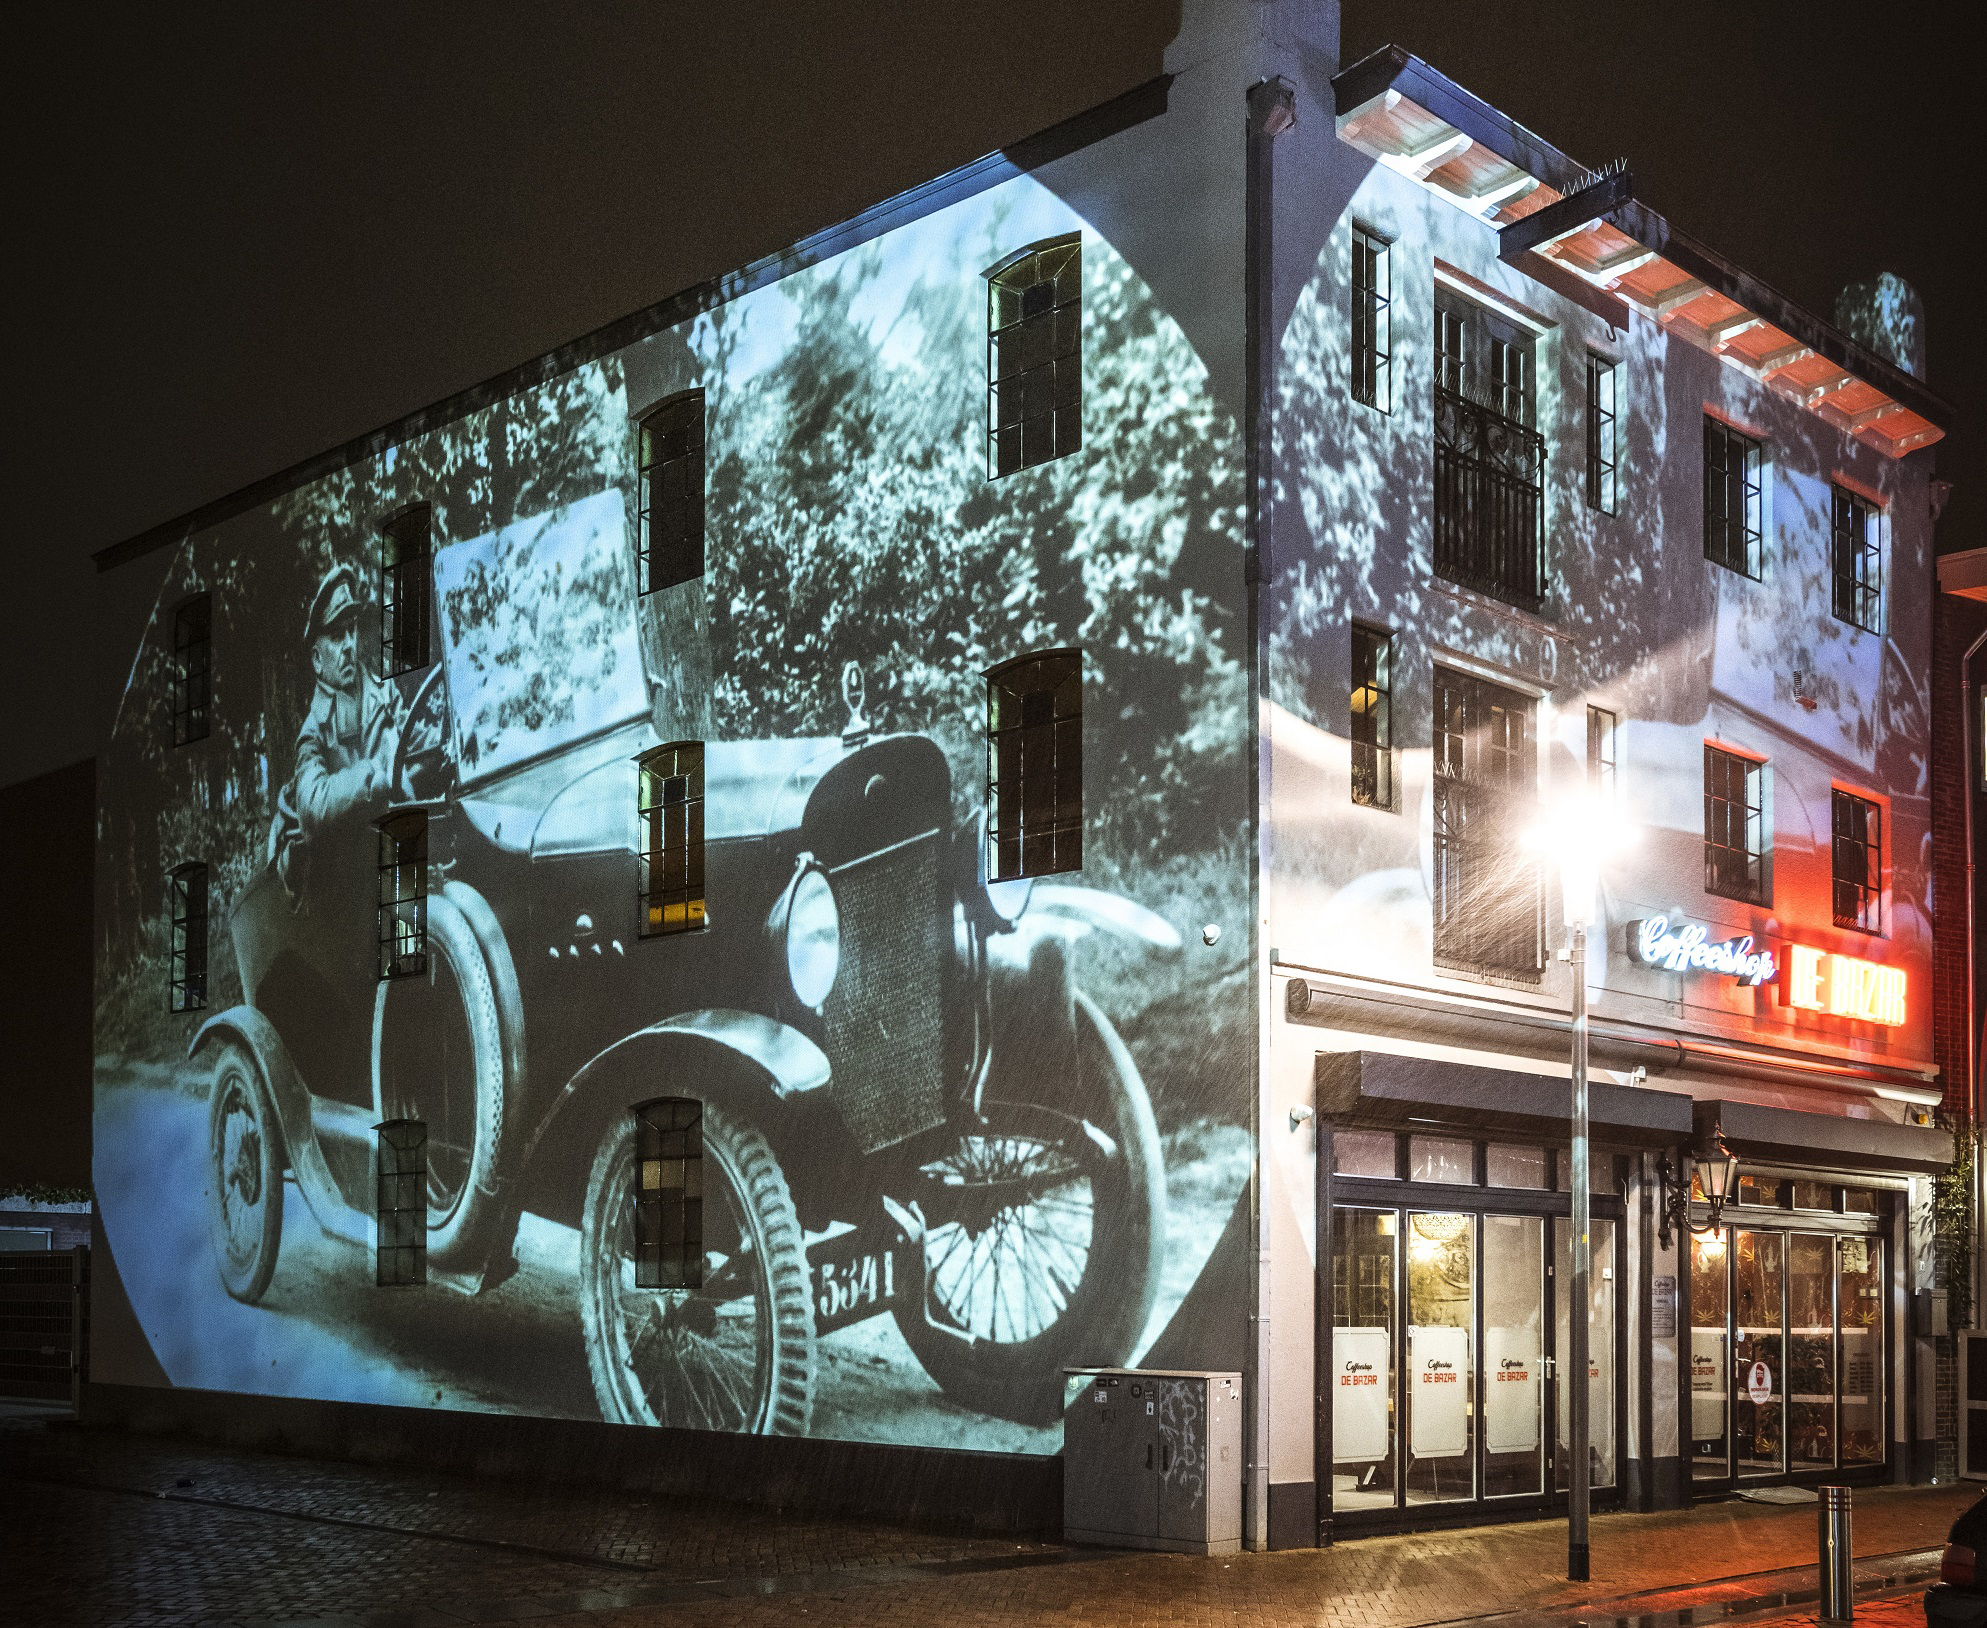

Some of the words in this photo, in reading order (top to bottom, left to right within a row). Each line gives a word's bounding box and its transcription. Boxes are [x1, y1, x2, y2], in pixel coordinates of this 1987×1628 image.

[1637, 915, 1776, 985] Coffeeshop
[1790, 943, 1825, 1010] DE
[1830, 953, 1907, 1026] BAZAR
[1345, 1360, 1373, 1373] Coffeeshop
[1427, 1359, 1453, 1371] Coffeeshop
[1501, 1358, 1524, 1370] Coffeeshop
[1497, 1371, 1506, 1382] DE
[1507, 1371, 1528, 1382] BAZAR
[1698, 1366, 1716, 1376] BAZAR
[1341, 1375, 1352, 1386] DE
[1353, 1375, 1378, 1386] BAZAR
[1423, 1372, 1433, 1383] DE
[1434, 1372, 1457, 1383] BAZAR
